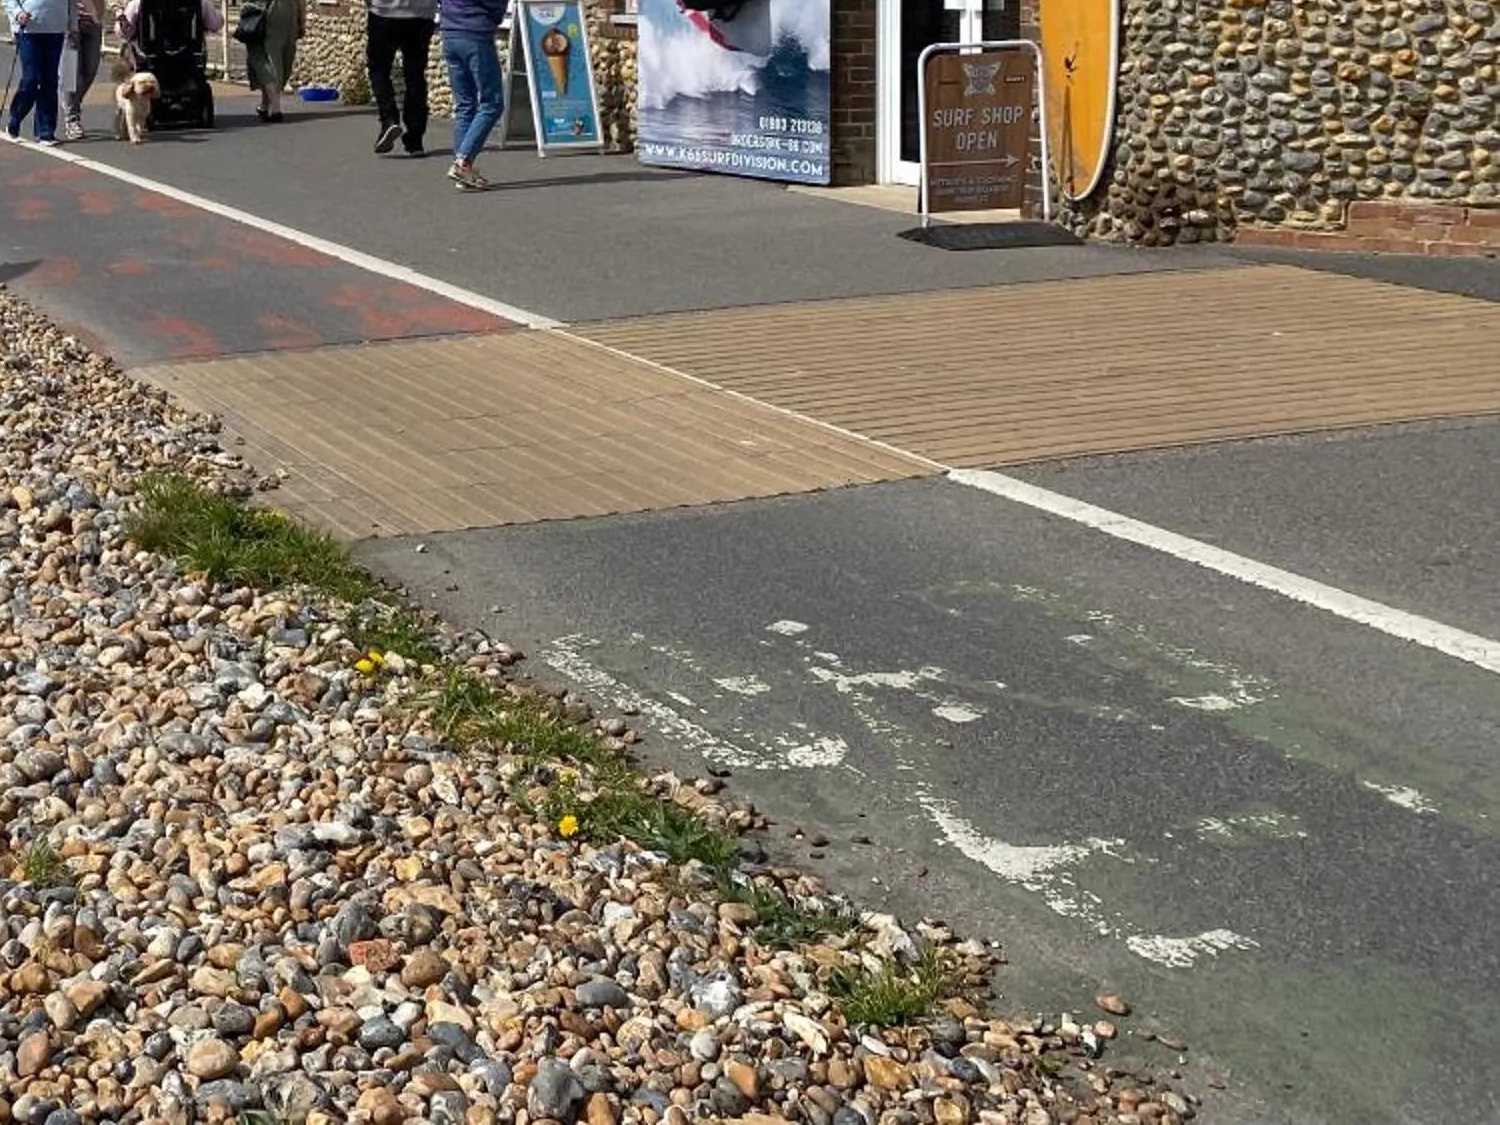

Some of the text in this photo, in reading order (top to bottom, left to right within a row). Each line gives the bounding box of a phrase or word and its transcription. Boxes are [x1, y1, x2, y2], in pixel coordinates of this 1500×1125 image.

[932, 106, 1024, 127] SURF SHOP
[956, 132, 998, 150] OPEN
